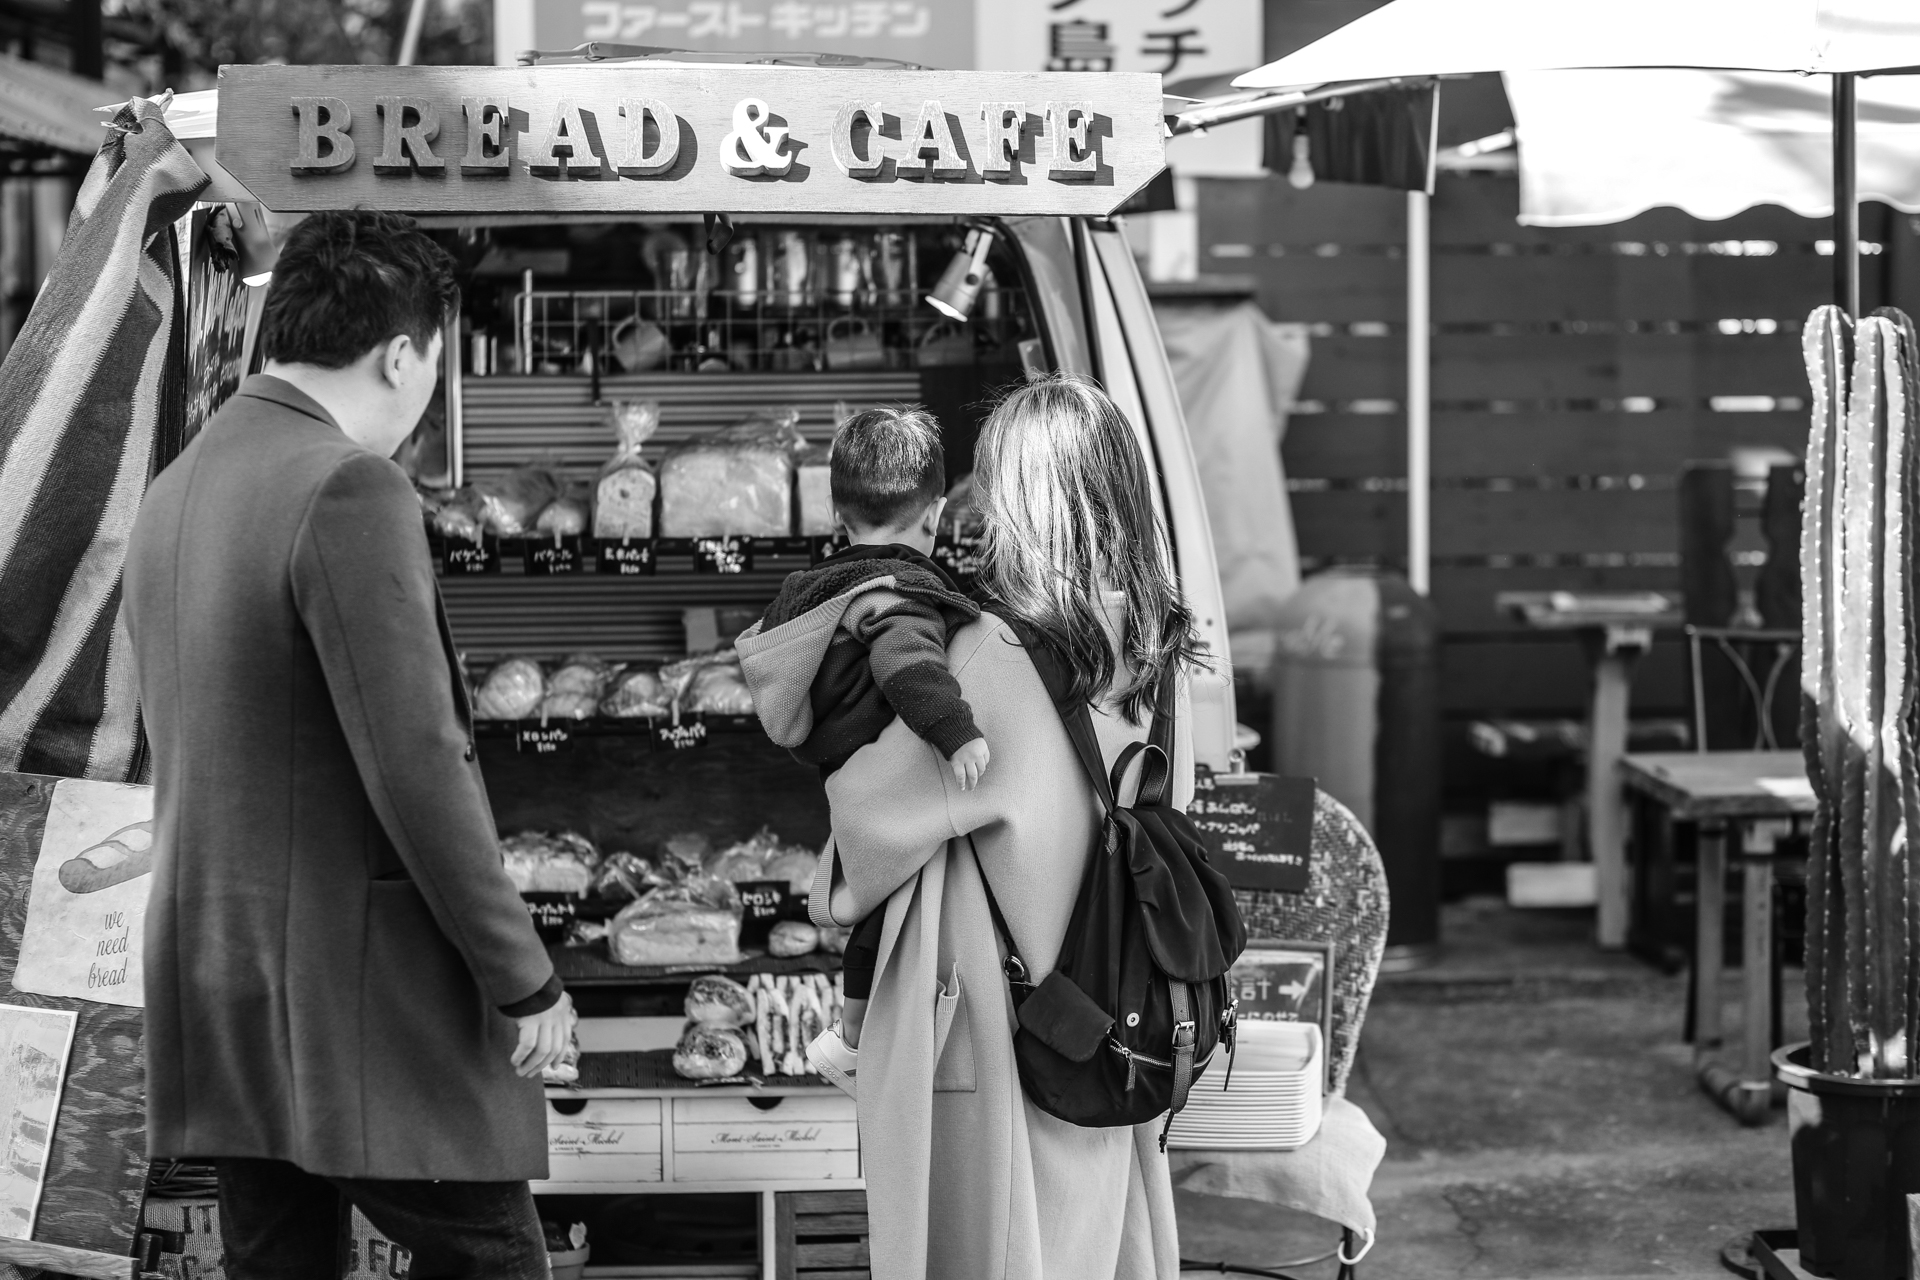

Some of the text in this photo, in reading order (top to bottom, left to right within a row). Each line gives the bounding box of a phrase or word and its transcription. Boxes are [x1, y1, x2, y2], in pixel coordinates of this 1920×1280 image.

[290, 96, 1098, 180] BREAD & CAFE
[104, 911, 125, 930] we
[96, 926, 130, 957] need
[88, 957, 129, 989] bread
[819, 1062, 841, 1081] adidas
